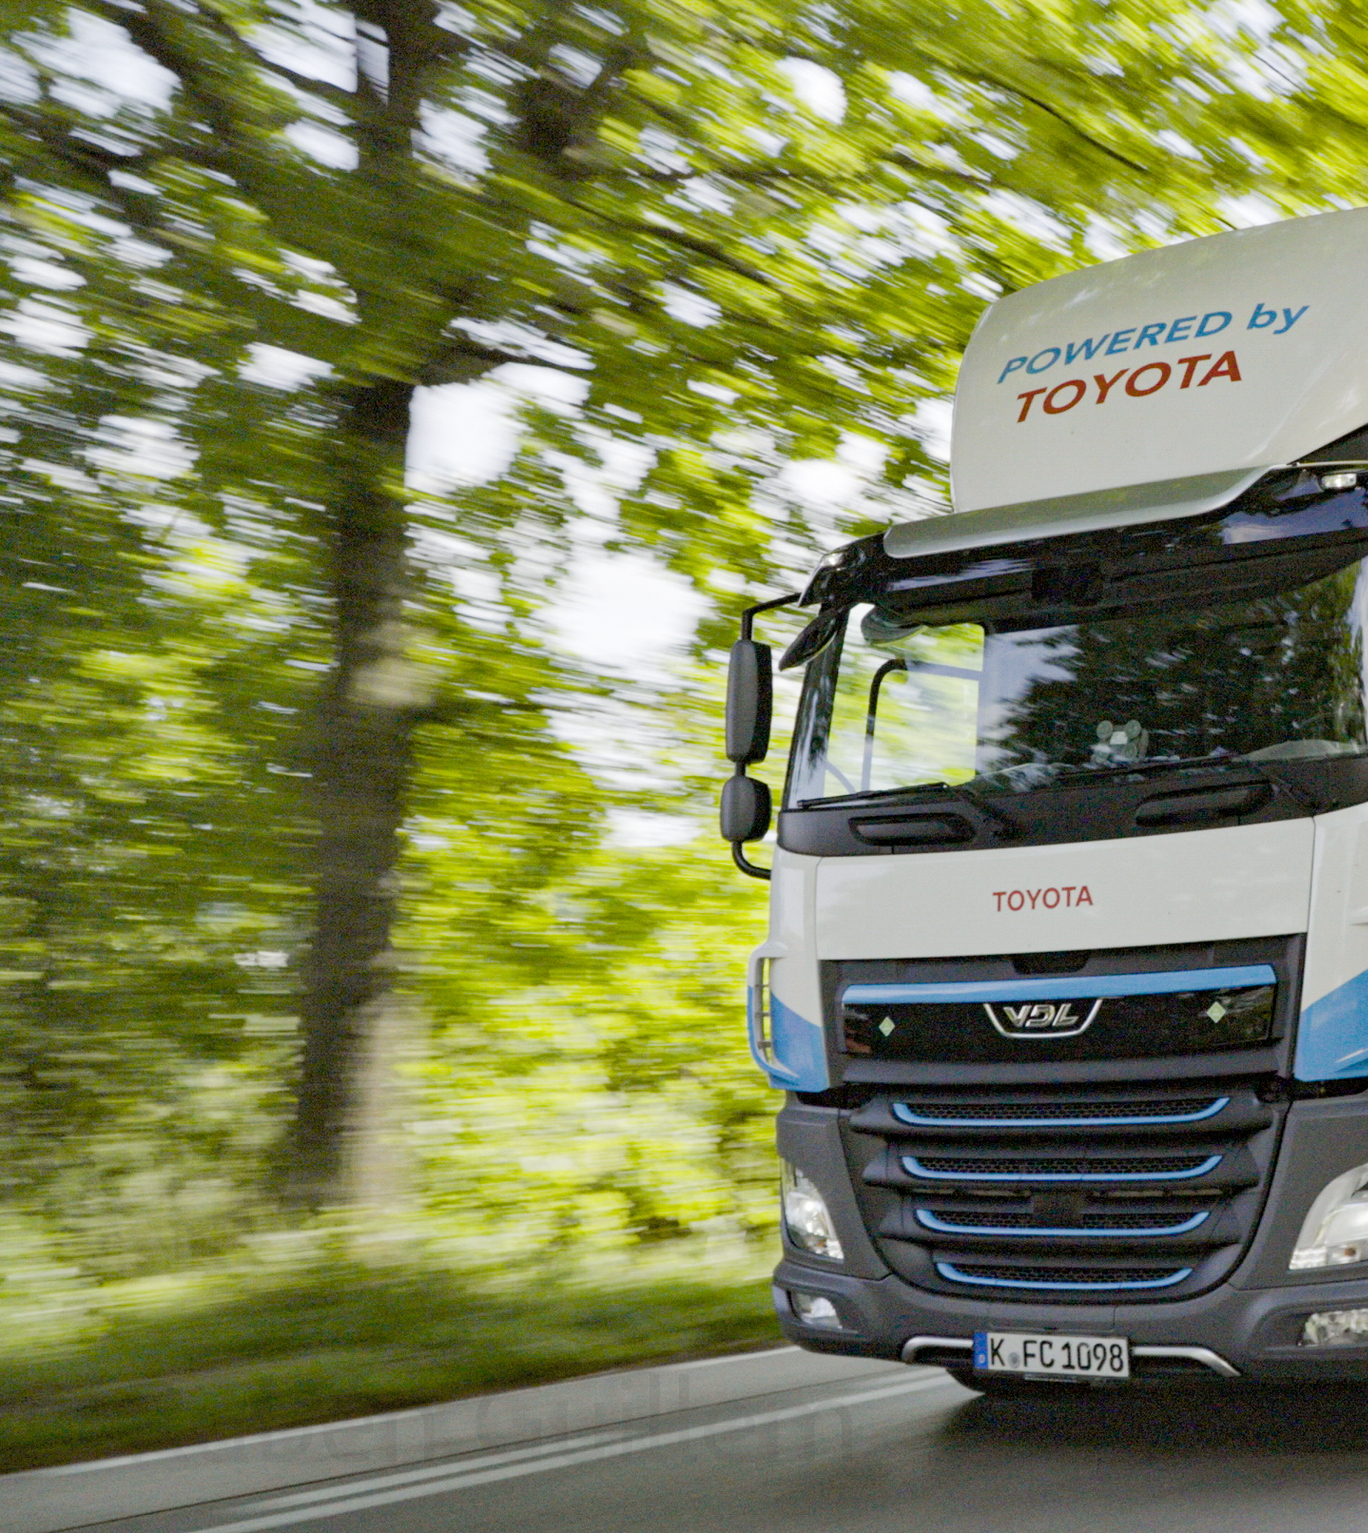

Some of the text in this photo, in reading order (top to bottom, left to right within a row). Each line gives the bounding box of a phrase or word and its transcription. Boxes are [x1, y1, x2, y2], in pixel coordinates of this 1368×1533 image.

[997, 303, 1310, 385] POWERED by
[1016, 350, 1242, 423] TOYOTA
[992, 885, 1093, 912] TOYOTA
[1003, 1003, 1081, 1028] VDL
[990, 1338, 1005, 1367] K
[1061, 1341, 1124, 1373] 1098
